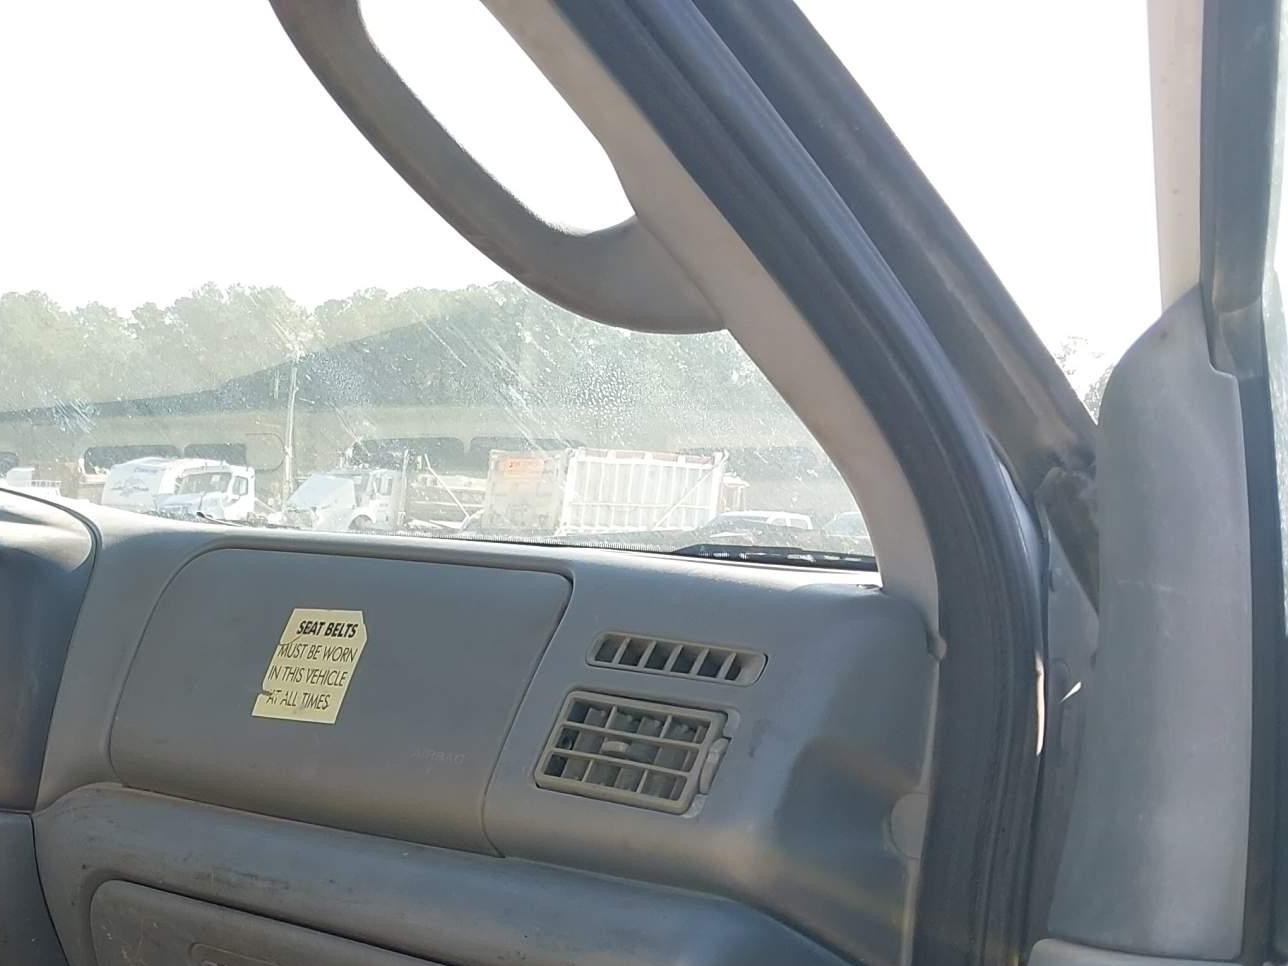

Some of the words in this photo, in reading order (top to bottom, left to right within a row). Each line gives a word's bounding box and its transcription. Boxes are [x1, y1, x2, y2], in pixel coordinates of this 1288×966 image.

[296, 620, 324, 635] SEAT
[324, 622, 358, 638] BELTS
[278, 643, 308, 659] MUST
[307, 645, 322, 660] BE
[323, 647, 358, 663] WORN
[268, 665, 283, 681] IN
[282, 666, 305, 683] THIS
[305, 668, 348, 687] VEHICLE
[266, 690, 282, 704] AT
[280, 691, 298, 707] ALL
[302, 692, 331, 710] TIMES
